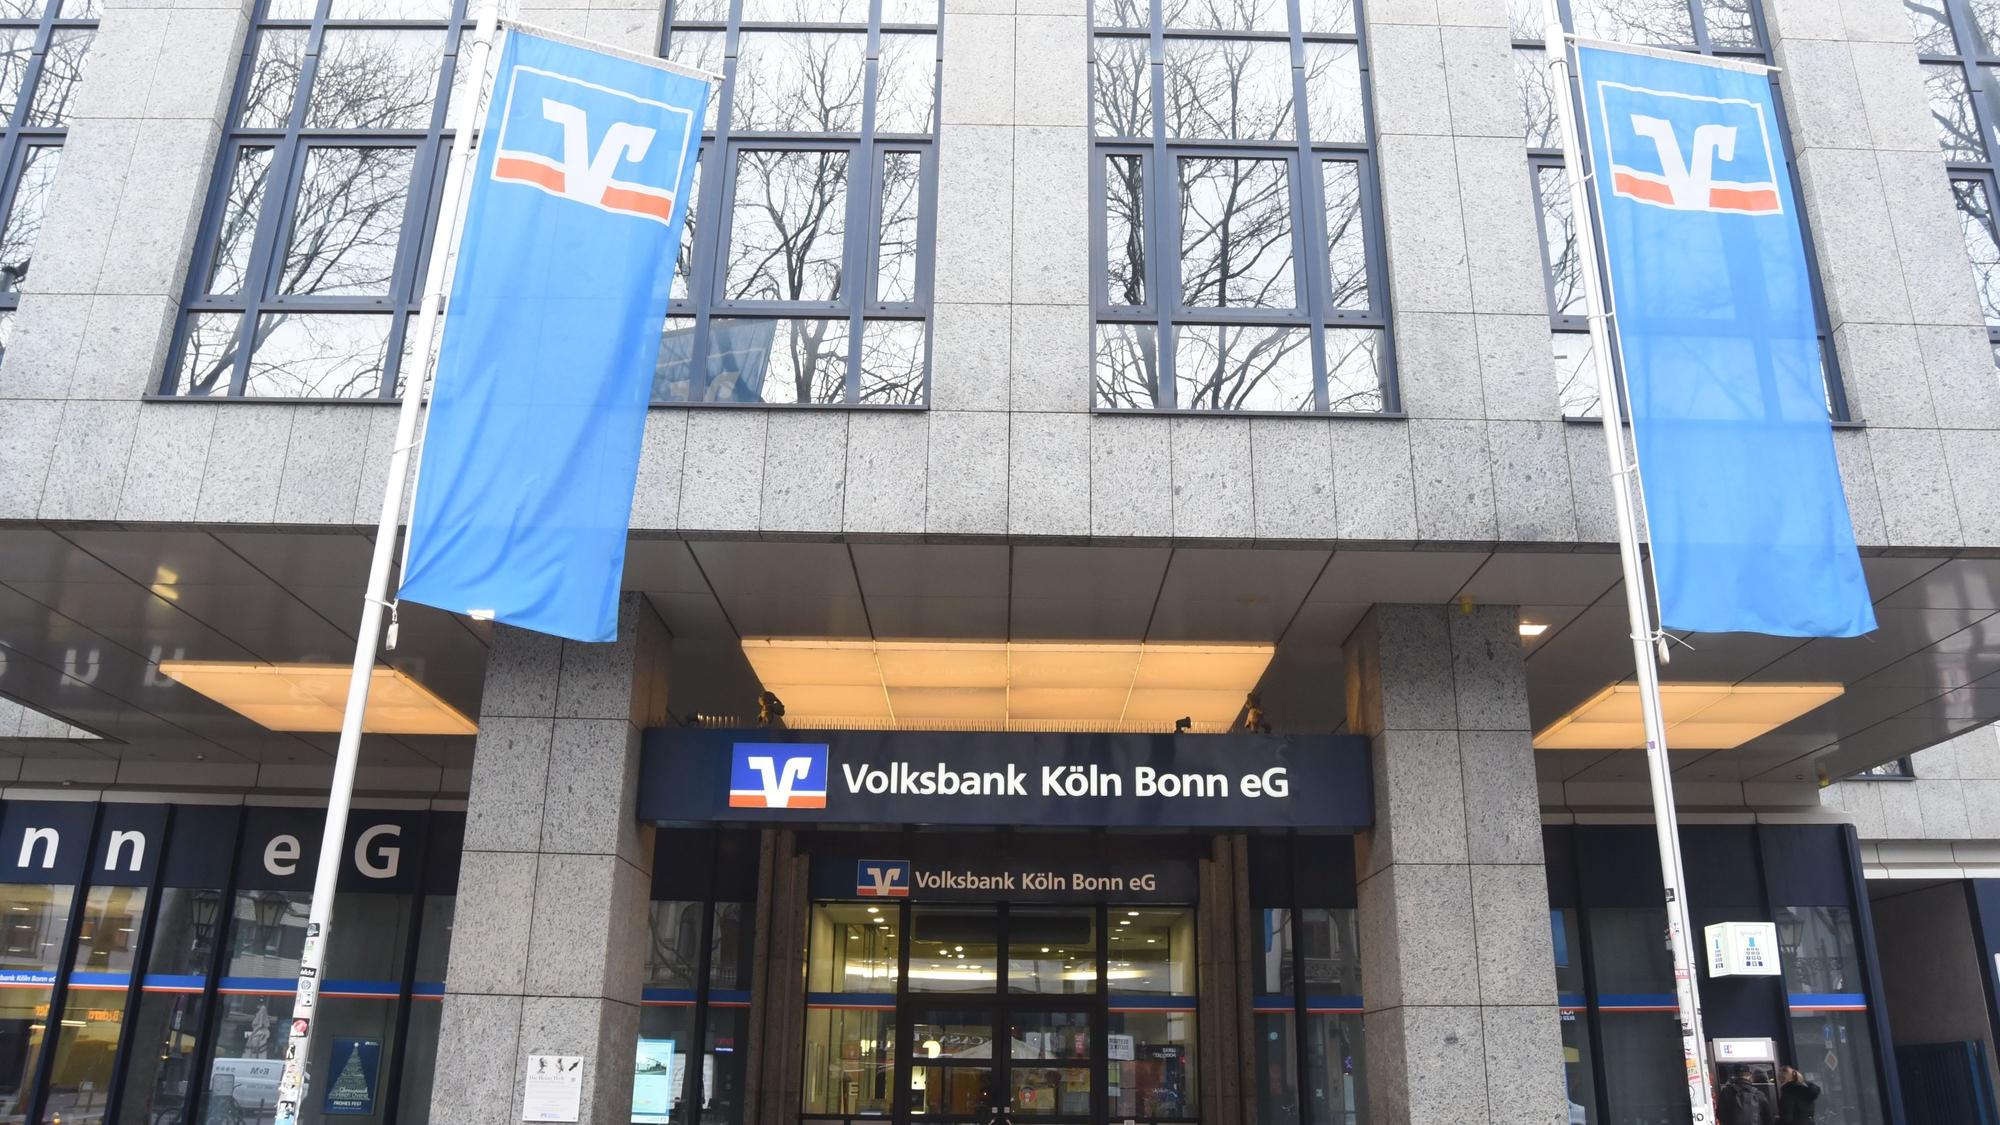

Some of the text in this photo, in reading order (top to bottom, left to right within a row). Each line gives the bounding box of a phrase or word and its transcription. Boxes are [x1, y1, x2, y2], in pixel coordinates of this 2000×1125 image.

[842, 762, 1289, 798] Volksbank Köln Bonn eG
[263, 824, 402, 879] eG
[915, 871, 1157, 891] Volksbank Köln Bonn eG
